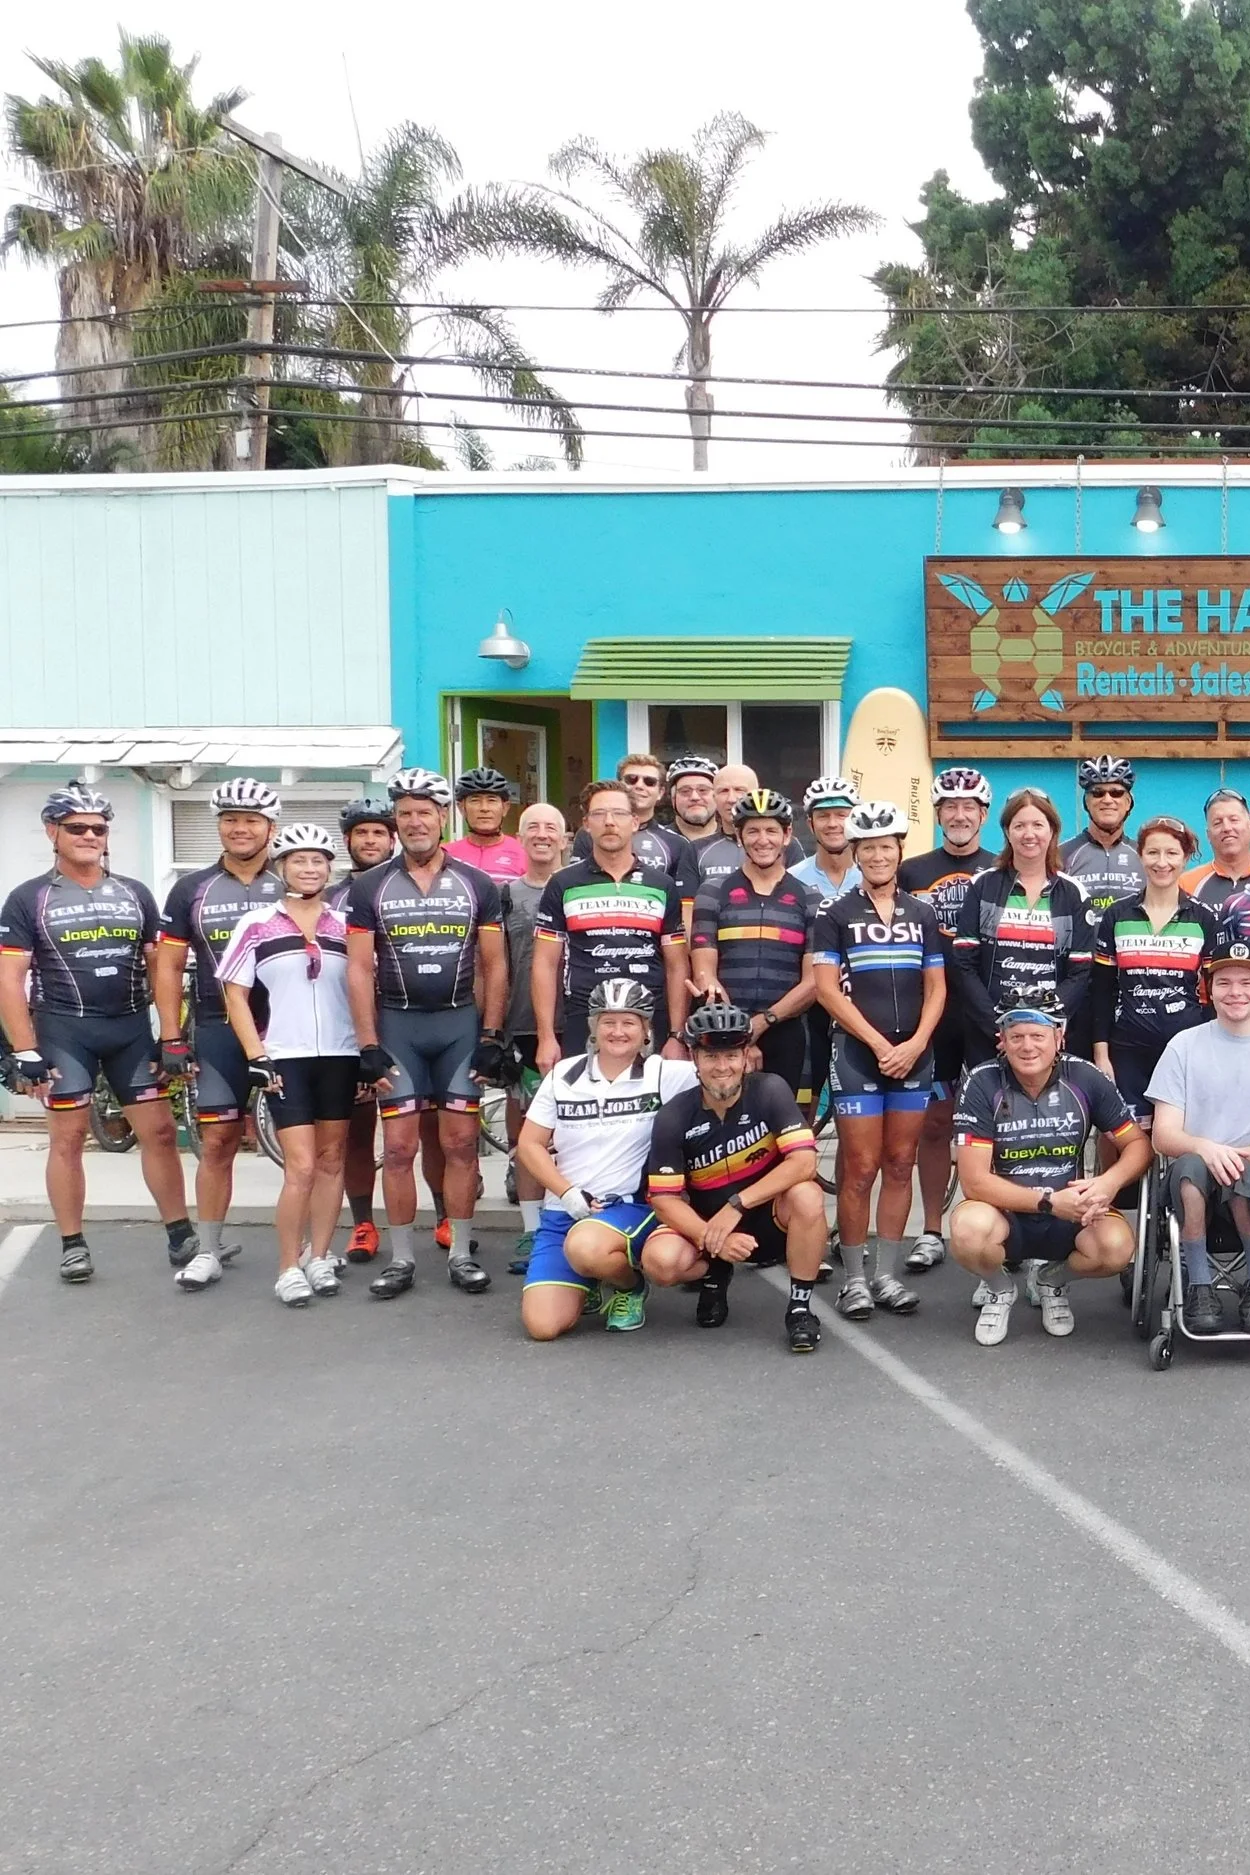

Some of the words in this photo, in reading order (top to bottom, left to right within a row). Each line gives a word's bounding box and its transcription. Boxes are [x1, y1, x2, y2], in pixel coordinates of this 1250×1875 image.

[1094, 588, 1183, 635] THE
[1075, 640, 1141, 656] BICYCLE
[1147, 640, 1158, 656] &
[1077, 661, 1175, 697] Rentals
[705, 865, 732, 875] TEAM
[1102, 872, 1127, 882] JOEY
[48, 904, 85, 918] TEAM
[87, 902, 118, 913] JOEY
[203, 902, 238, 915] TEAM
[382, 899, 416, 910] TEAM
[419, 897, 451, 907] JOEY
[578, 899, 610, 910] TEAM
[613, 899, 640, 909] JOEY
[60, 925, 138, 943] JoeyA.org
[390, 922, 466, 938] JoeyA.org
[848, 922, 923, 944] TOSH
[1120, 939, 1147, 947] TEAM
[1149, 939, 1175, 948] JOEY
[418, 963, 442, 974] HBO
[1165, 1000, 1186, 1014] HBO
[557, 1103, 597, 1117] TEAM
[604, 1098, 642, 1114] JOEY
[997, 1118, 1028, 1133] TEAM
[1030, 1116, 1061, 1129] JOEY
[687, 1120, 770, 1170] CALIFORNIA
[1000, 1144, 1076, 1160] JoeyA.org
